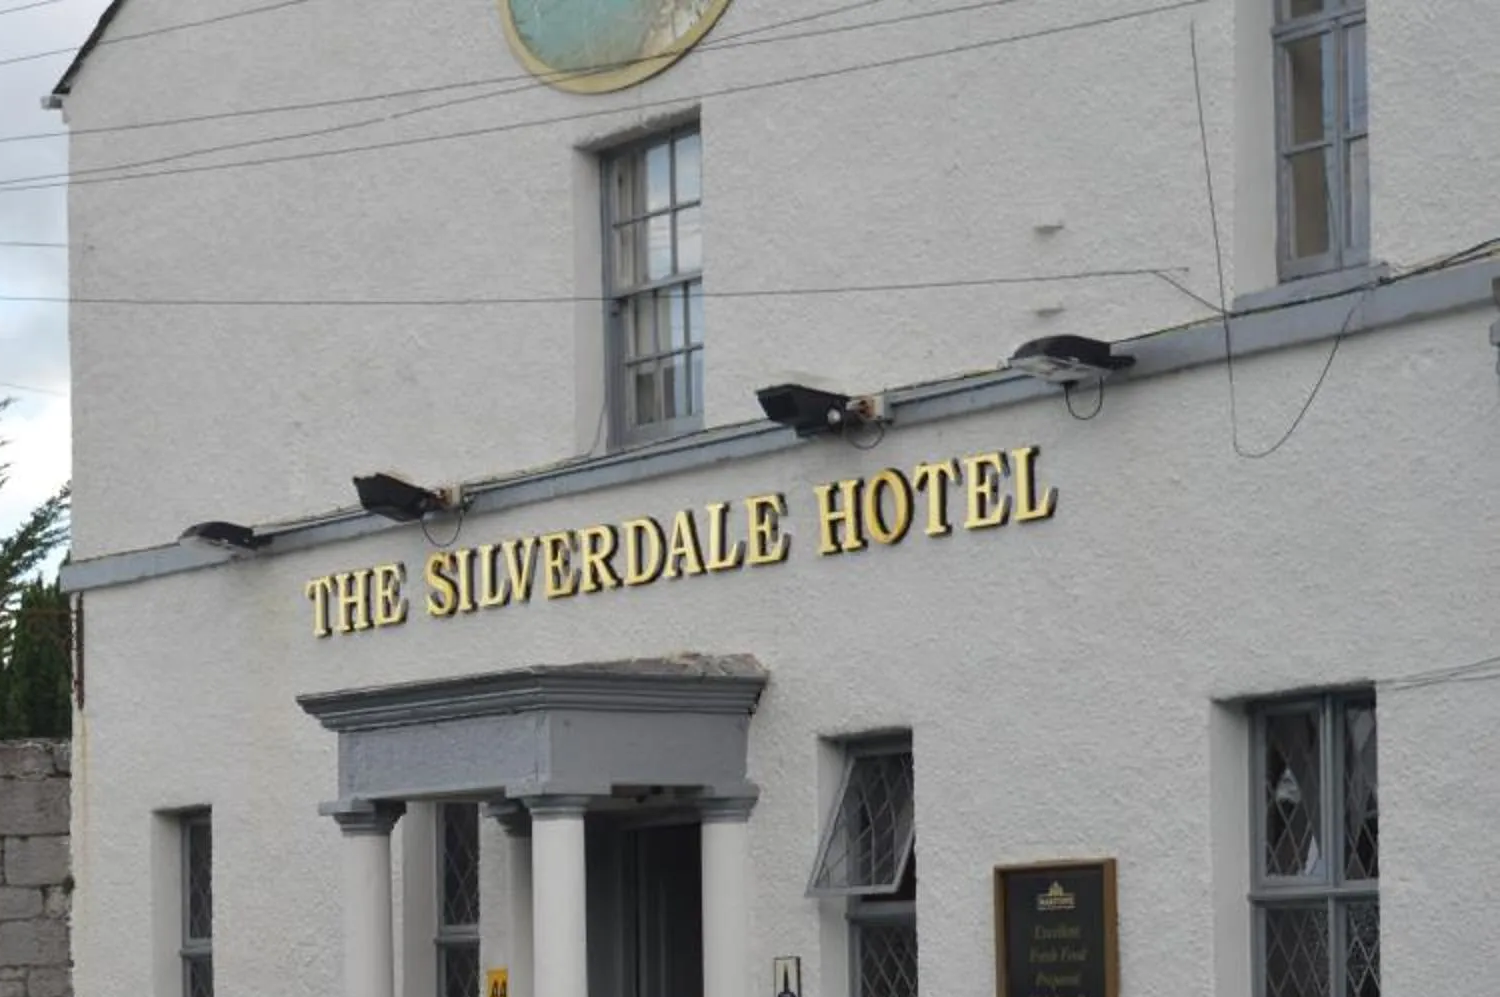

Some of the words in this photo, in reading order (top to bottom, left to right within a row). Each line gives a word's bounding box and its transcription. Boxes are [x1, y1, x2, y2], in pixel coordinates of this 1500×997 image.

[306, 561, 408, 638] THE
[424, 493, 790, 618] SILVERDALE
[813, 445, 1060, 558] HOTEL
